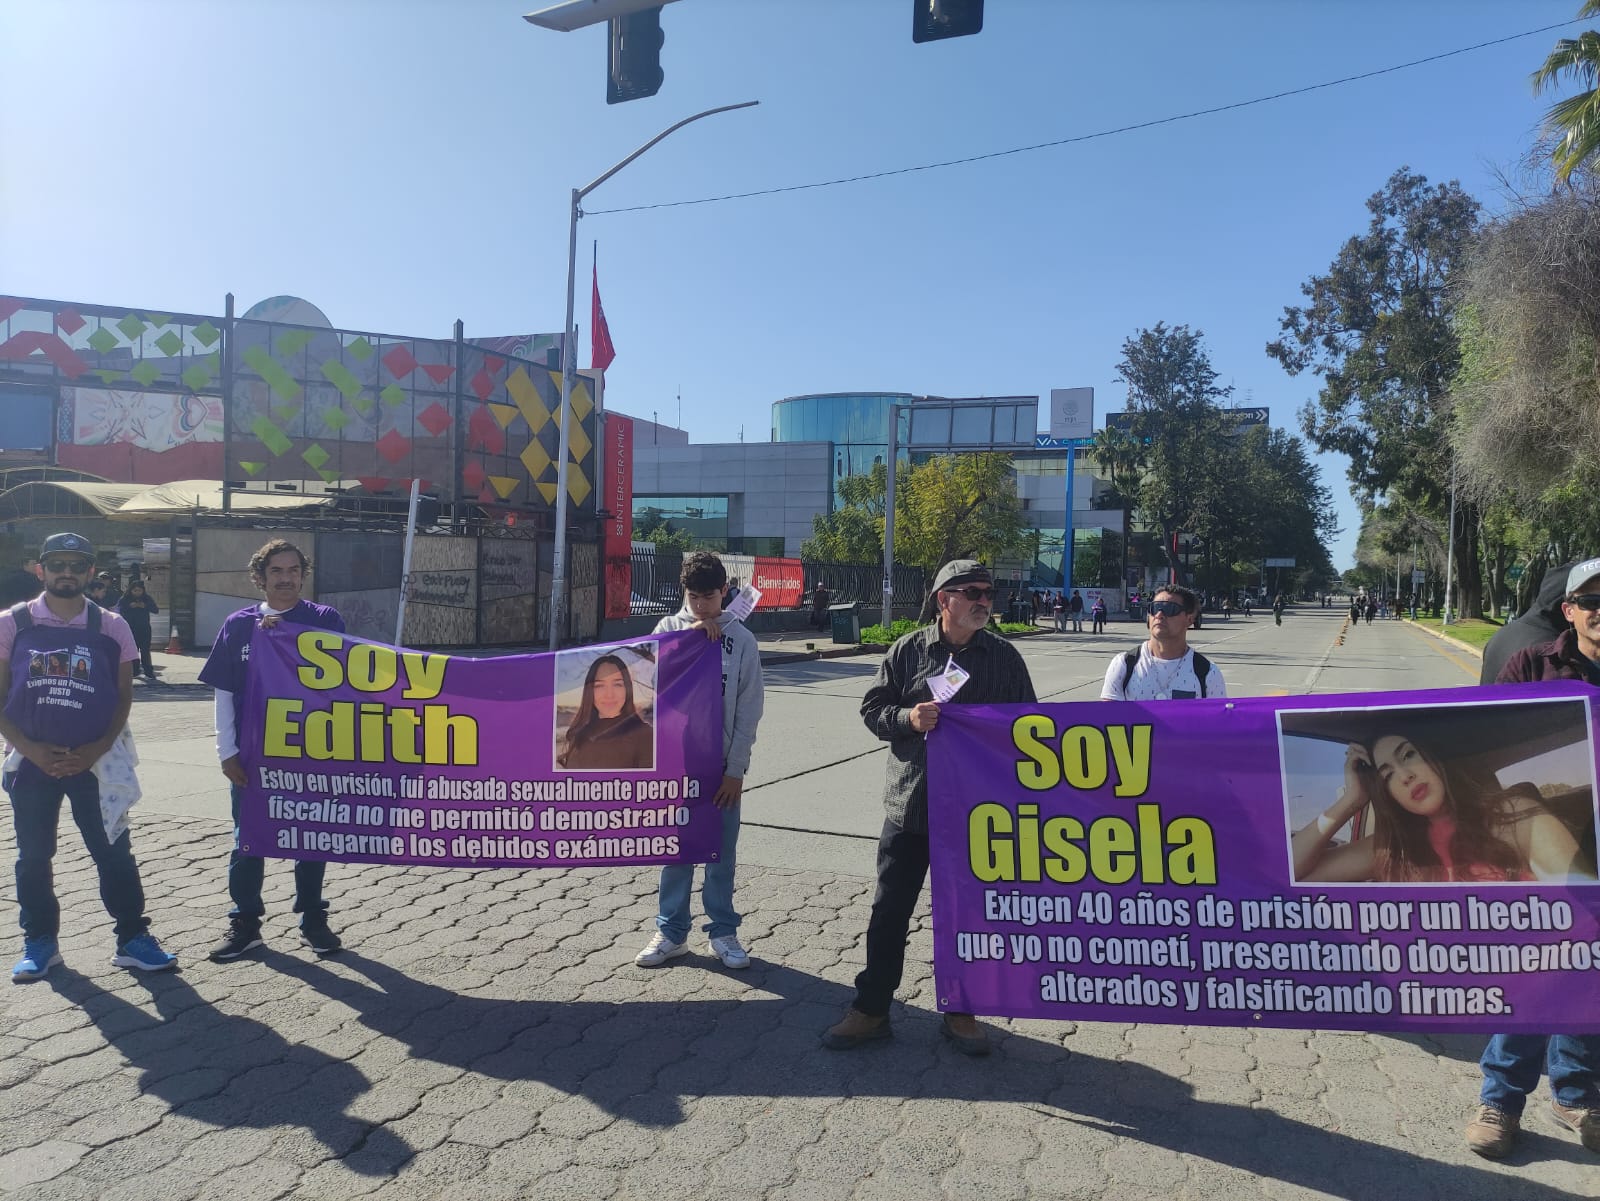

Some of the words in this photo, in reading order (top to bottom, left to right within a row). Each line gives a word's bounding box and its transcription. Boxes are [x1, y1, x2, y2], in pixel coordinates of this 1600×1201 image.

[616, 423, 625, 522] INTERCERAMIC
[757, 575, 801, 589] Bienvenidos
[296, 630, 450, 700] Soy
[48, 687, 71, 696] JUSTO
[69, 680, 95, 693] Proceso
[263, 697, 479, 766] Edith
[1011, 713, 1152, 798] Soy
[259, 766, 302, 794] Estoy
[306, 772, 329, 793] en
[331, 772, 397, 799] prisión,
[400, 774, 424, 799] fui
[427, 775, 507, 801] abusada
[511, 776, 632, 801] sexualmente
[636, 779, 679, 803] pero
[682, 776, 700, 799] la
[268, 795, 351, 824] fiscalía
[355, 804, 384, 827] no
[389, 806, 425, 829] me
[430, 805, 534, 832] permitió
[539, 804, 690, 832] demostrarlo
[277, 826, 298, 849] al
[303, 828, 404, 856] negarme
[410, 832, 447, 858] los
[451, 835, 550, 859] debidos
[555, 834, 680, 859] exámenes
[968, 801, 1218, 885] Gisela
[984, 889, 1072, 926] Exigen
[1077, 891, 1113, 924] 40
[1119, 891, 1191, 928] años
[1196, 894, 1235, 928] de
[1241, 895, 1353, 931] prisión
[1359, 899, 1413, 934] por
[1419, 900, 1462, 931] un
[1467, 895, 1573, 931] hecho
[957, 932, 1005, 962] que
[1009, 933, 1042, 964] yo
[1048, 934, 1082, 964] no
[1088, 934, 1196, 971] cometí,
[1202, 938, 1401, 971] presentando
[1040, 970, 1178, 1007] alterados
[1182, 980, 1200, 1011] y
[1205, 977, 1393, 1014] falsificando
[1399, 980, 1513, 1015] firmas.
